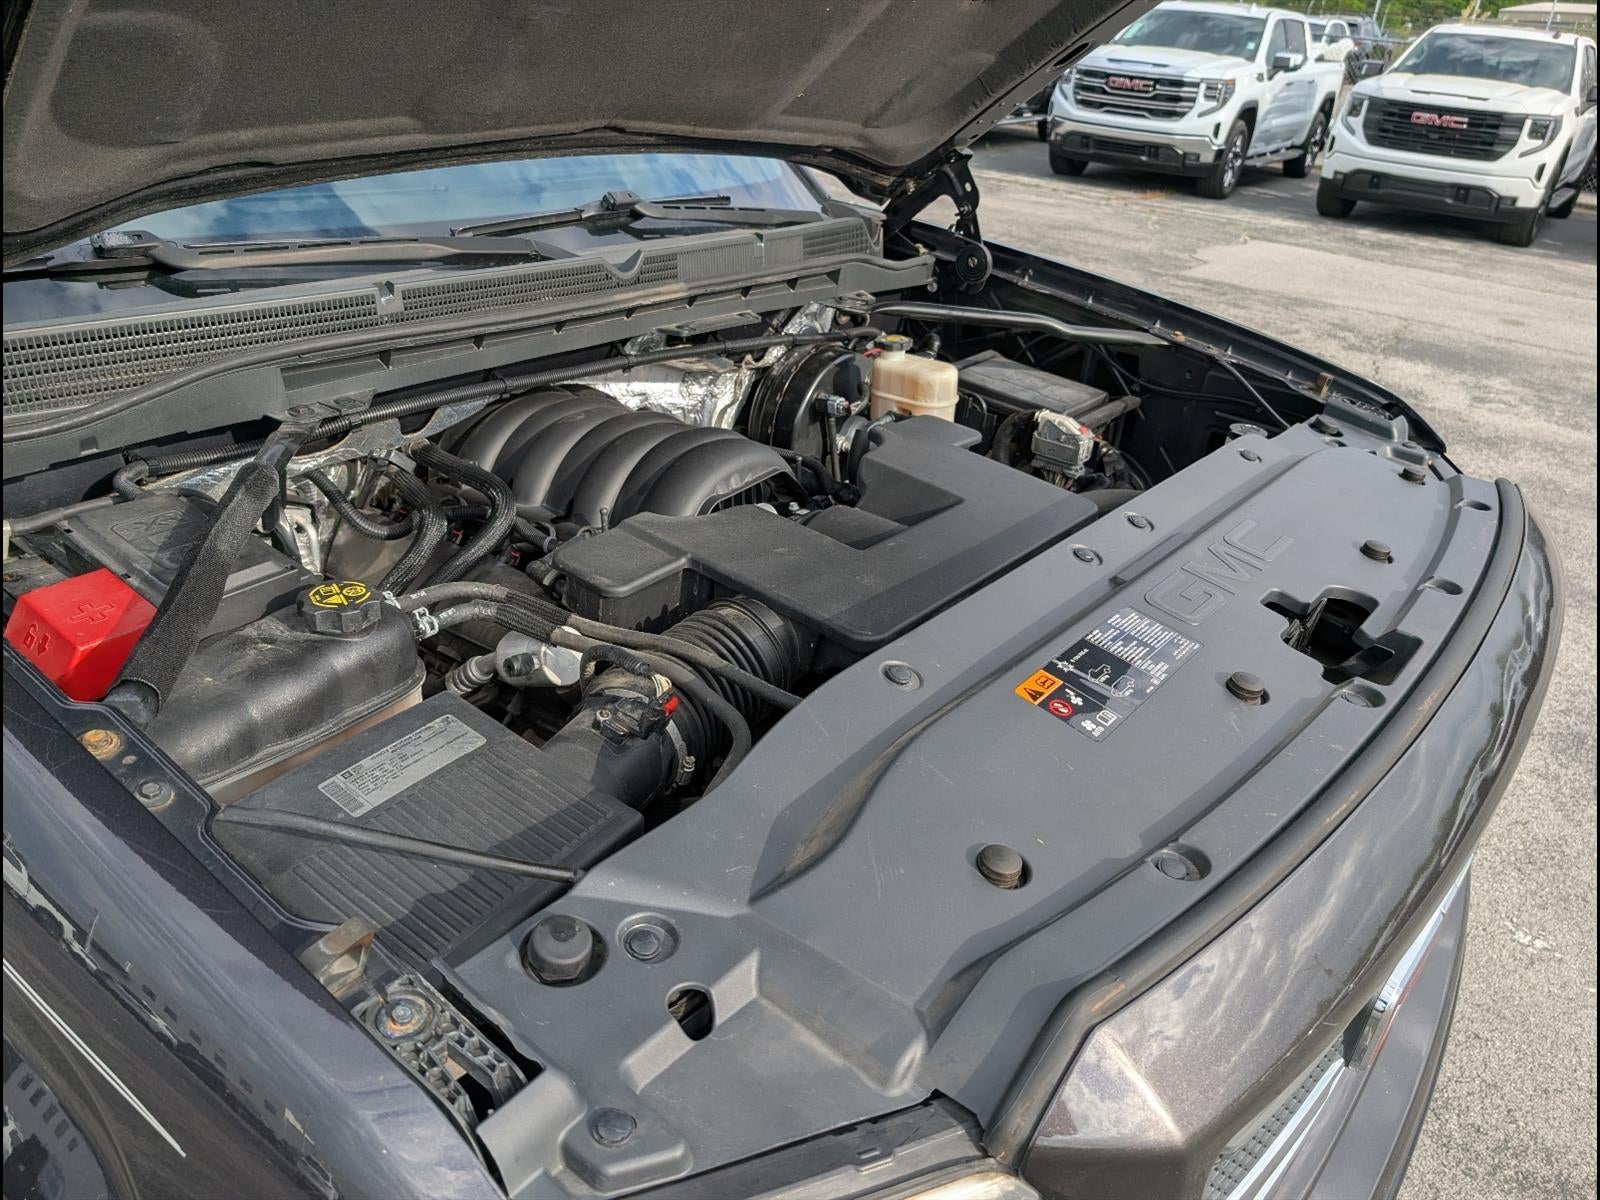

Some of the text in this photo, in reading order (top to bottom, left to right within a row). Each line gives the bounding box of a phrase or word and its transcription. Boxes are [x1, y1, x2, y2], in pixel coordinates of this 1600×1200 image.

[1107, 76, 1154, 91] GMC
[1410, 111, 1468, 129] GMC
[1143, 517, 1295, 626] GMC
